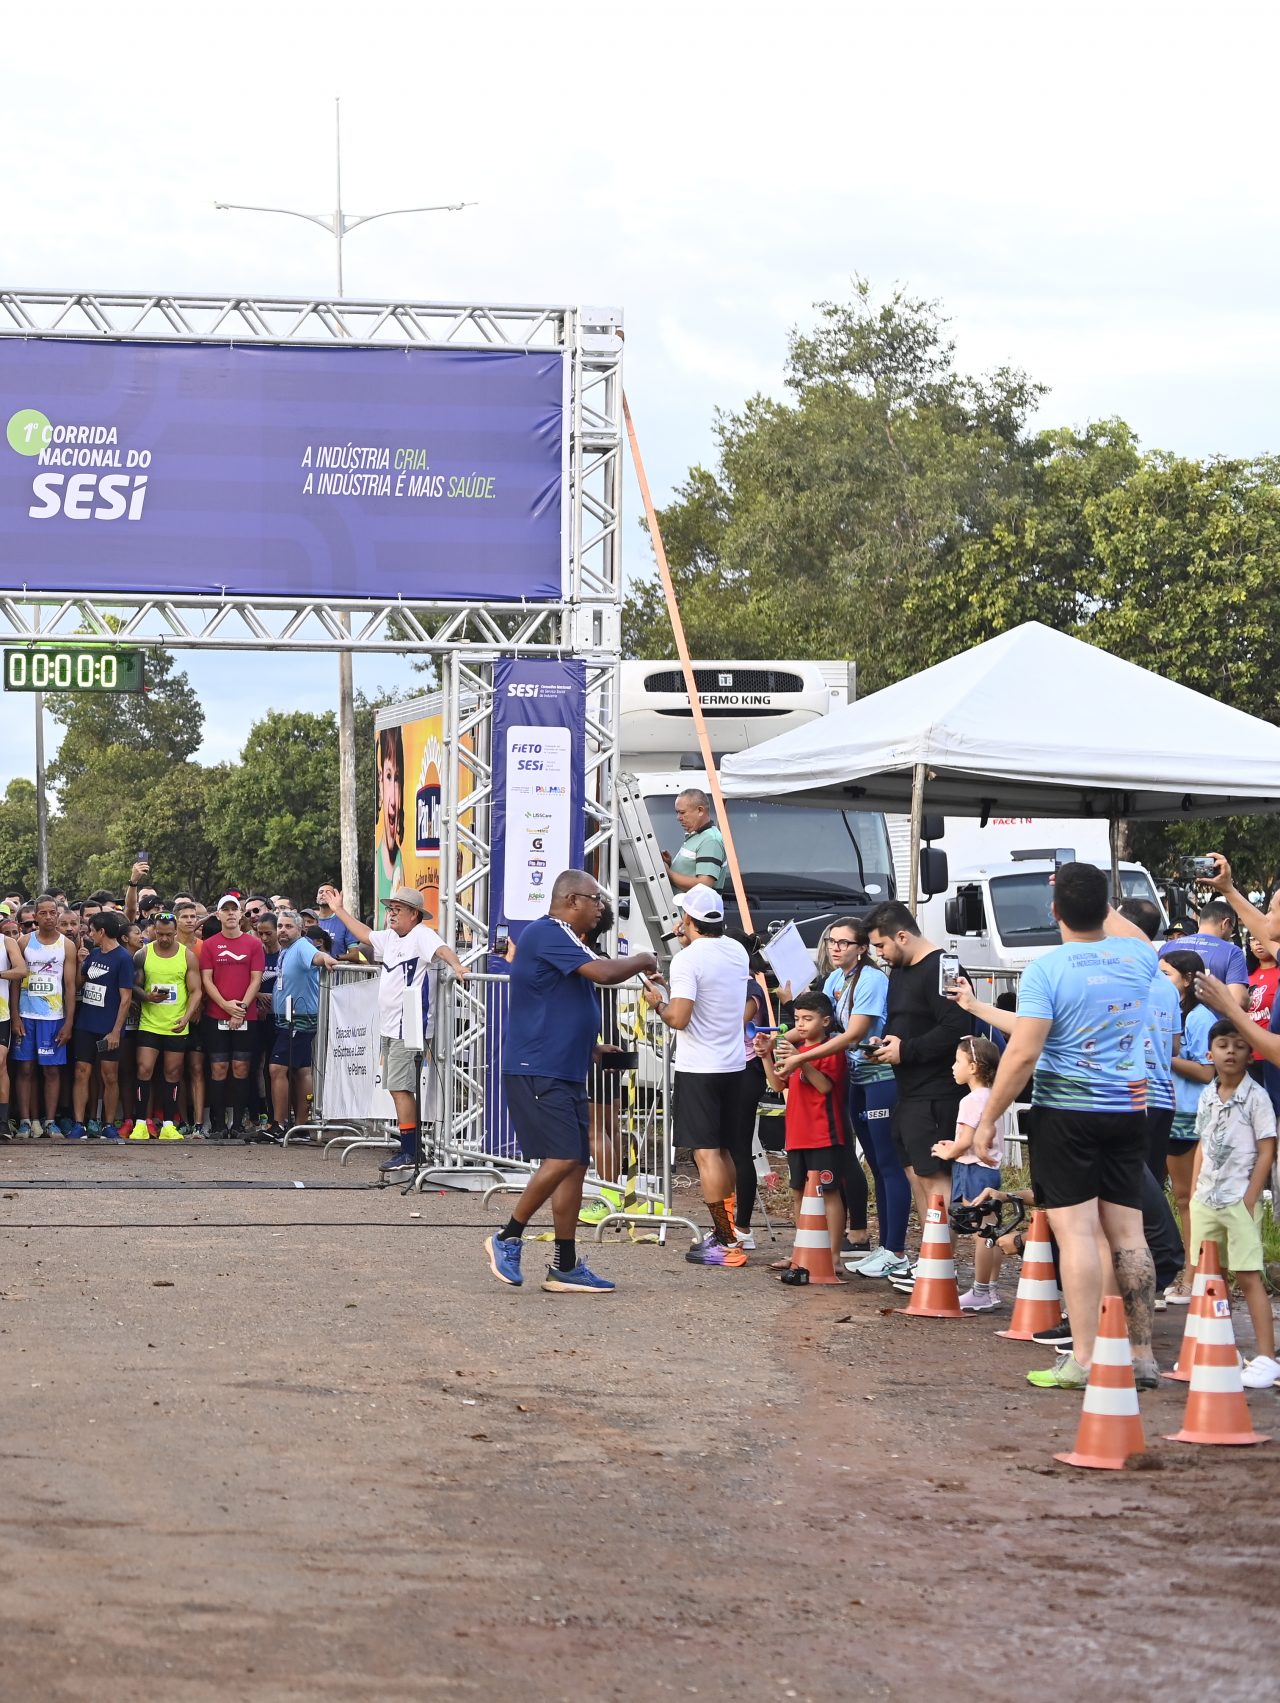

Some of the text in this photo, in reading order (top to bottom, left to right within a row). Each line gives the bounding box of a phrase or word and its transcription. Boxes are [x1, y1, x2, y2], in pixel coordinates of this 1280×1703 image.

[41, 425, 118, 445] CORRIDA
[38, 447, 152, 468] NACIONAL DO
[301, 442, 430, 471] A INDÚSTRIA CRIA.
[303, 469, 496, 499] A INDÚSTRIA É MAIS SAÚDE.
[9, 653, 117, 688] 00:00:0
[686, 695, 771, 705] TERMO KING
[535, 786, 566, 794] PALMAS
[30, 982, 52, 991] 1013
